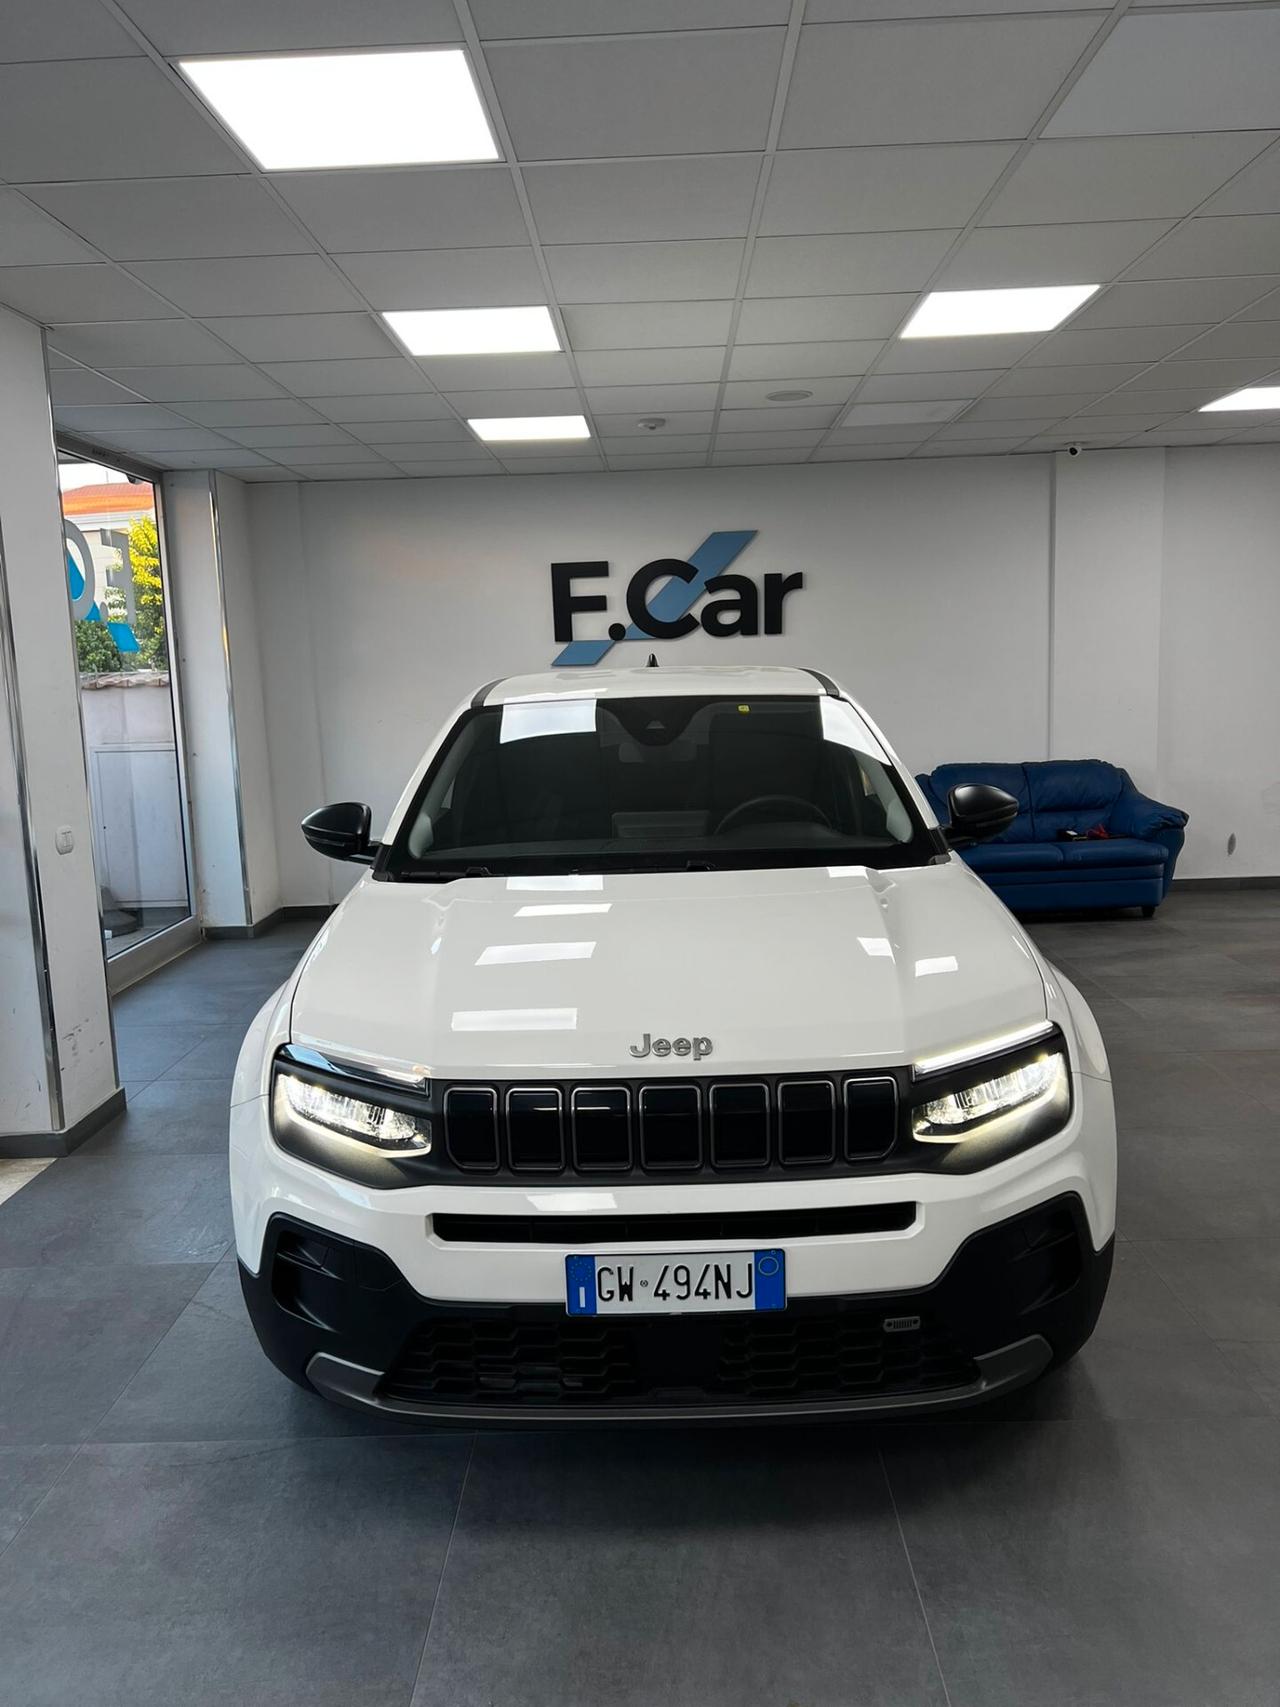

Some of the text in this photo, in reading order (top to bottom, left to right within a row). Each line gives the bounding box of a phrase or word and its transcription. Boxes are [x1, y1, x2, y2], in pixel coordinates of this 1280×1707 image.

[551, 559, 803, 642] F.Car
[629, 1033, 713, 1061] Jeep
[597, 1265, 634, 1302] GW
[653, 1263, 753, 1301] 494NJ
